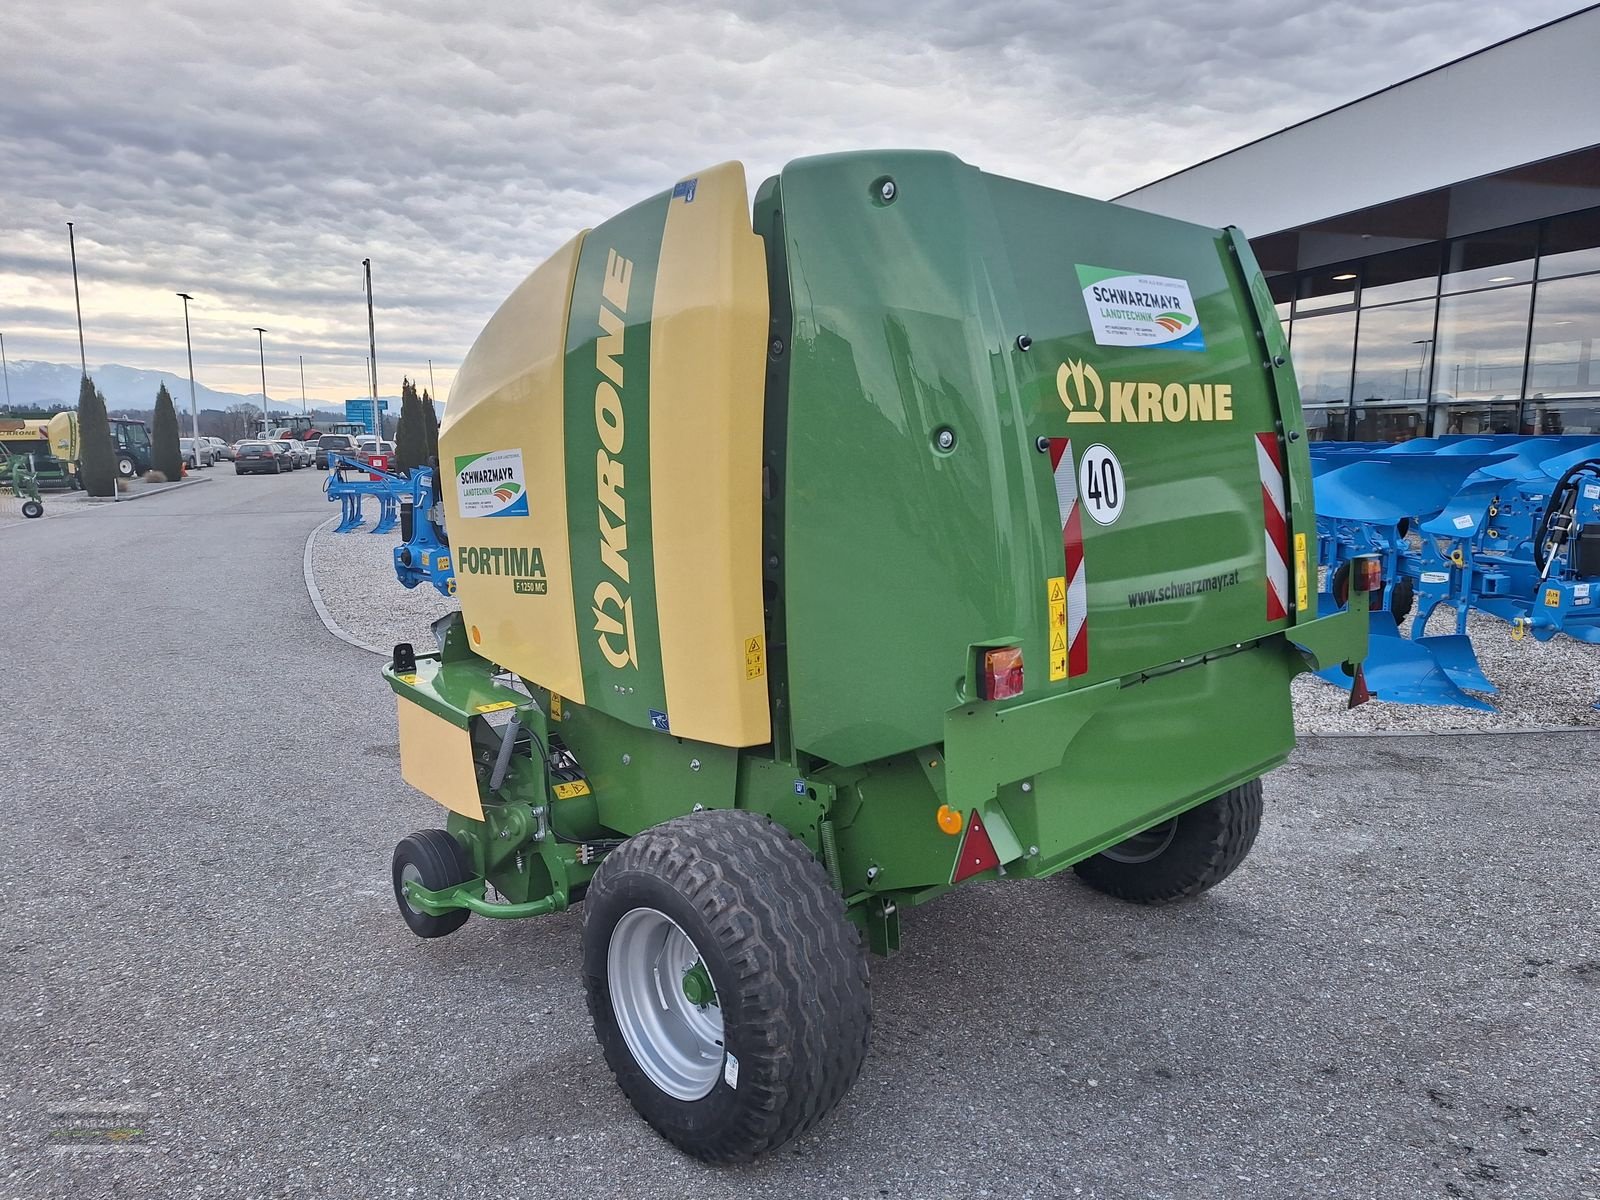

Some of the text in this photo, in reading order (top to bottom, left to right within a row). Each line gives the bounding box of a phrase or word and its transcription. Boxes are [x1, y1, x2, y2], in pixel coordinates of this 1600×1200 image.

[1093, 286, 1182, 310] SCHWARZMAYR
[1100, 308, 1155, 323] LANDTECHNIK
[594, 247, 634, 584] KRONE
[1110, 382, 1233, 422] KRONE
[460, 467, 514, 485] SCHWARZMAYR
[1087, 458, 1119, 510] 40
[463, 486, 493, 497] LANDTECHNIK
[458, 546, 547, 577] FORTIMA
[516, 582, 546, 592] F 1250 MC
[1127, 568, 1240, 608] www.schwarzmayr.at
